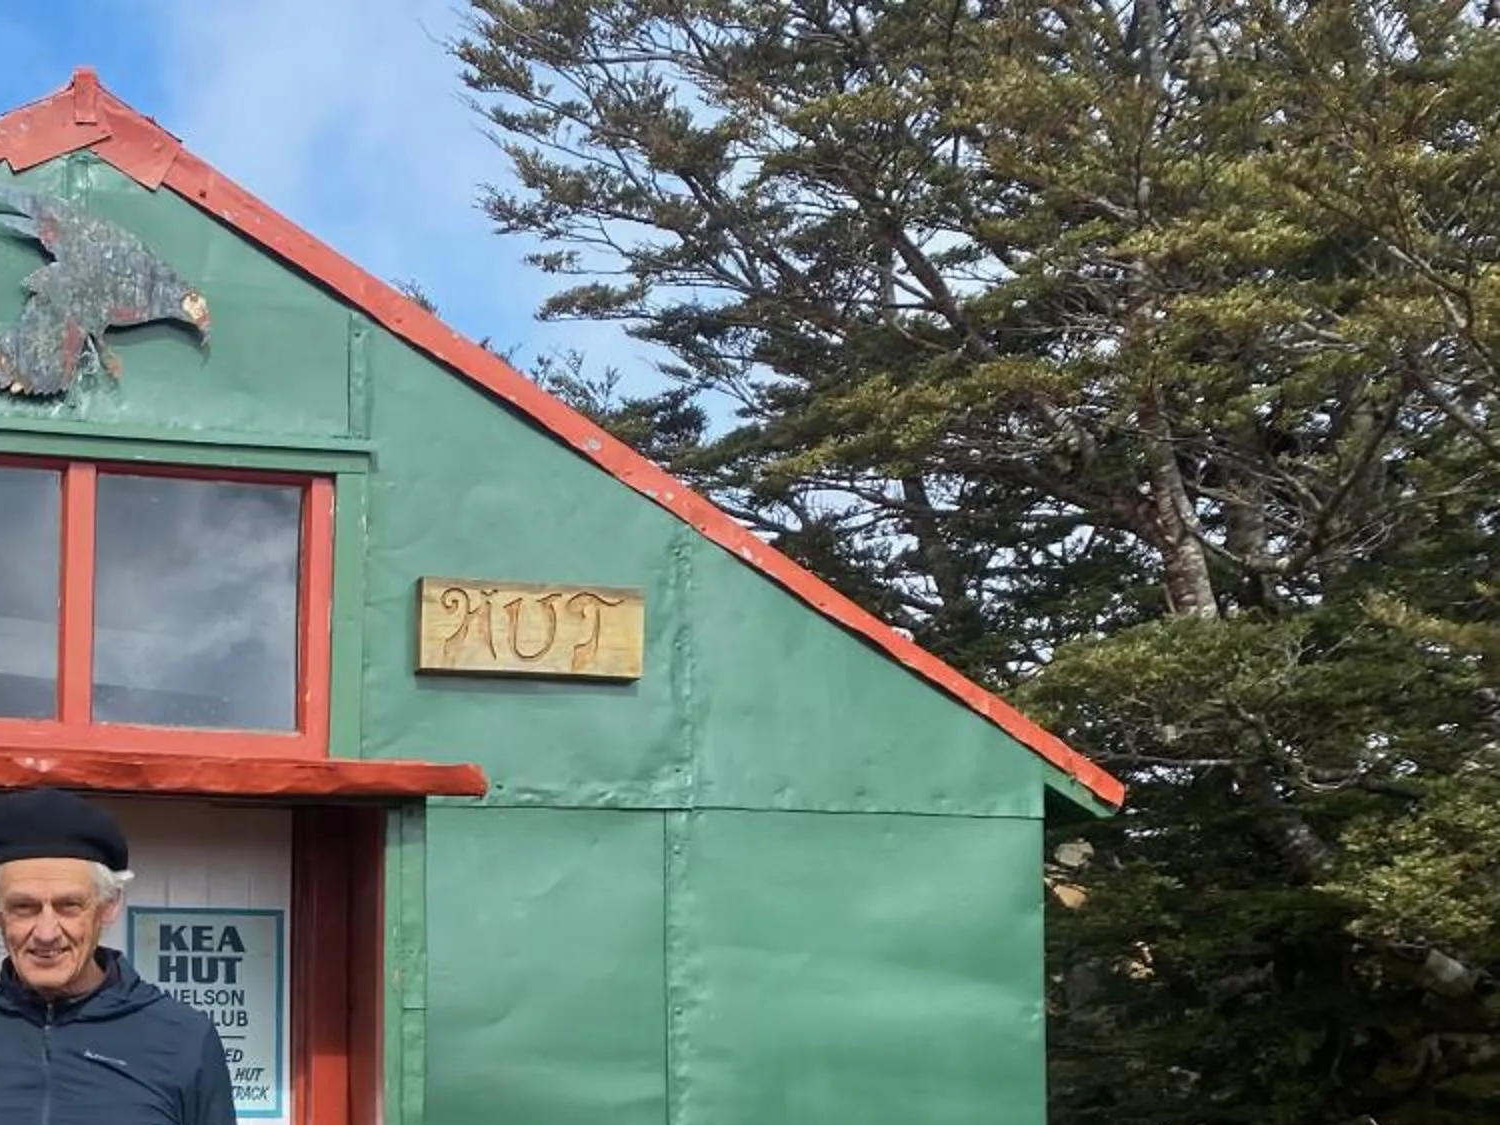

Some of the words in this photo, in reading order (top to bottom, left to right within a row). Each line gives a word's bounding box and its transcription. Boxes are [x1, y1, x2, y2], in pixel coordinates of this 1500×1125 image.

[440, 587, 625, 672] HUT
[158, 923, 246, 953] KEA
[158, 954, 243, 985] HUT
[209, 1009, 249, 1028] LUB
[224, 1047, 244, 1063] ED
[234, 1066, 265, 1081] HUT
